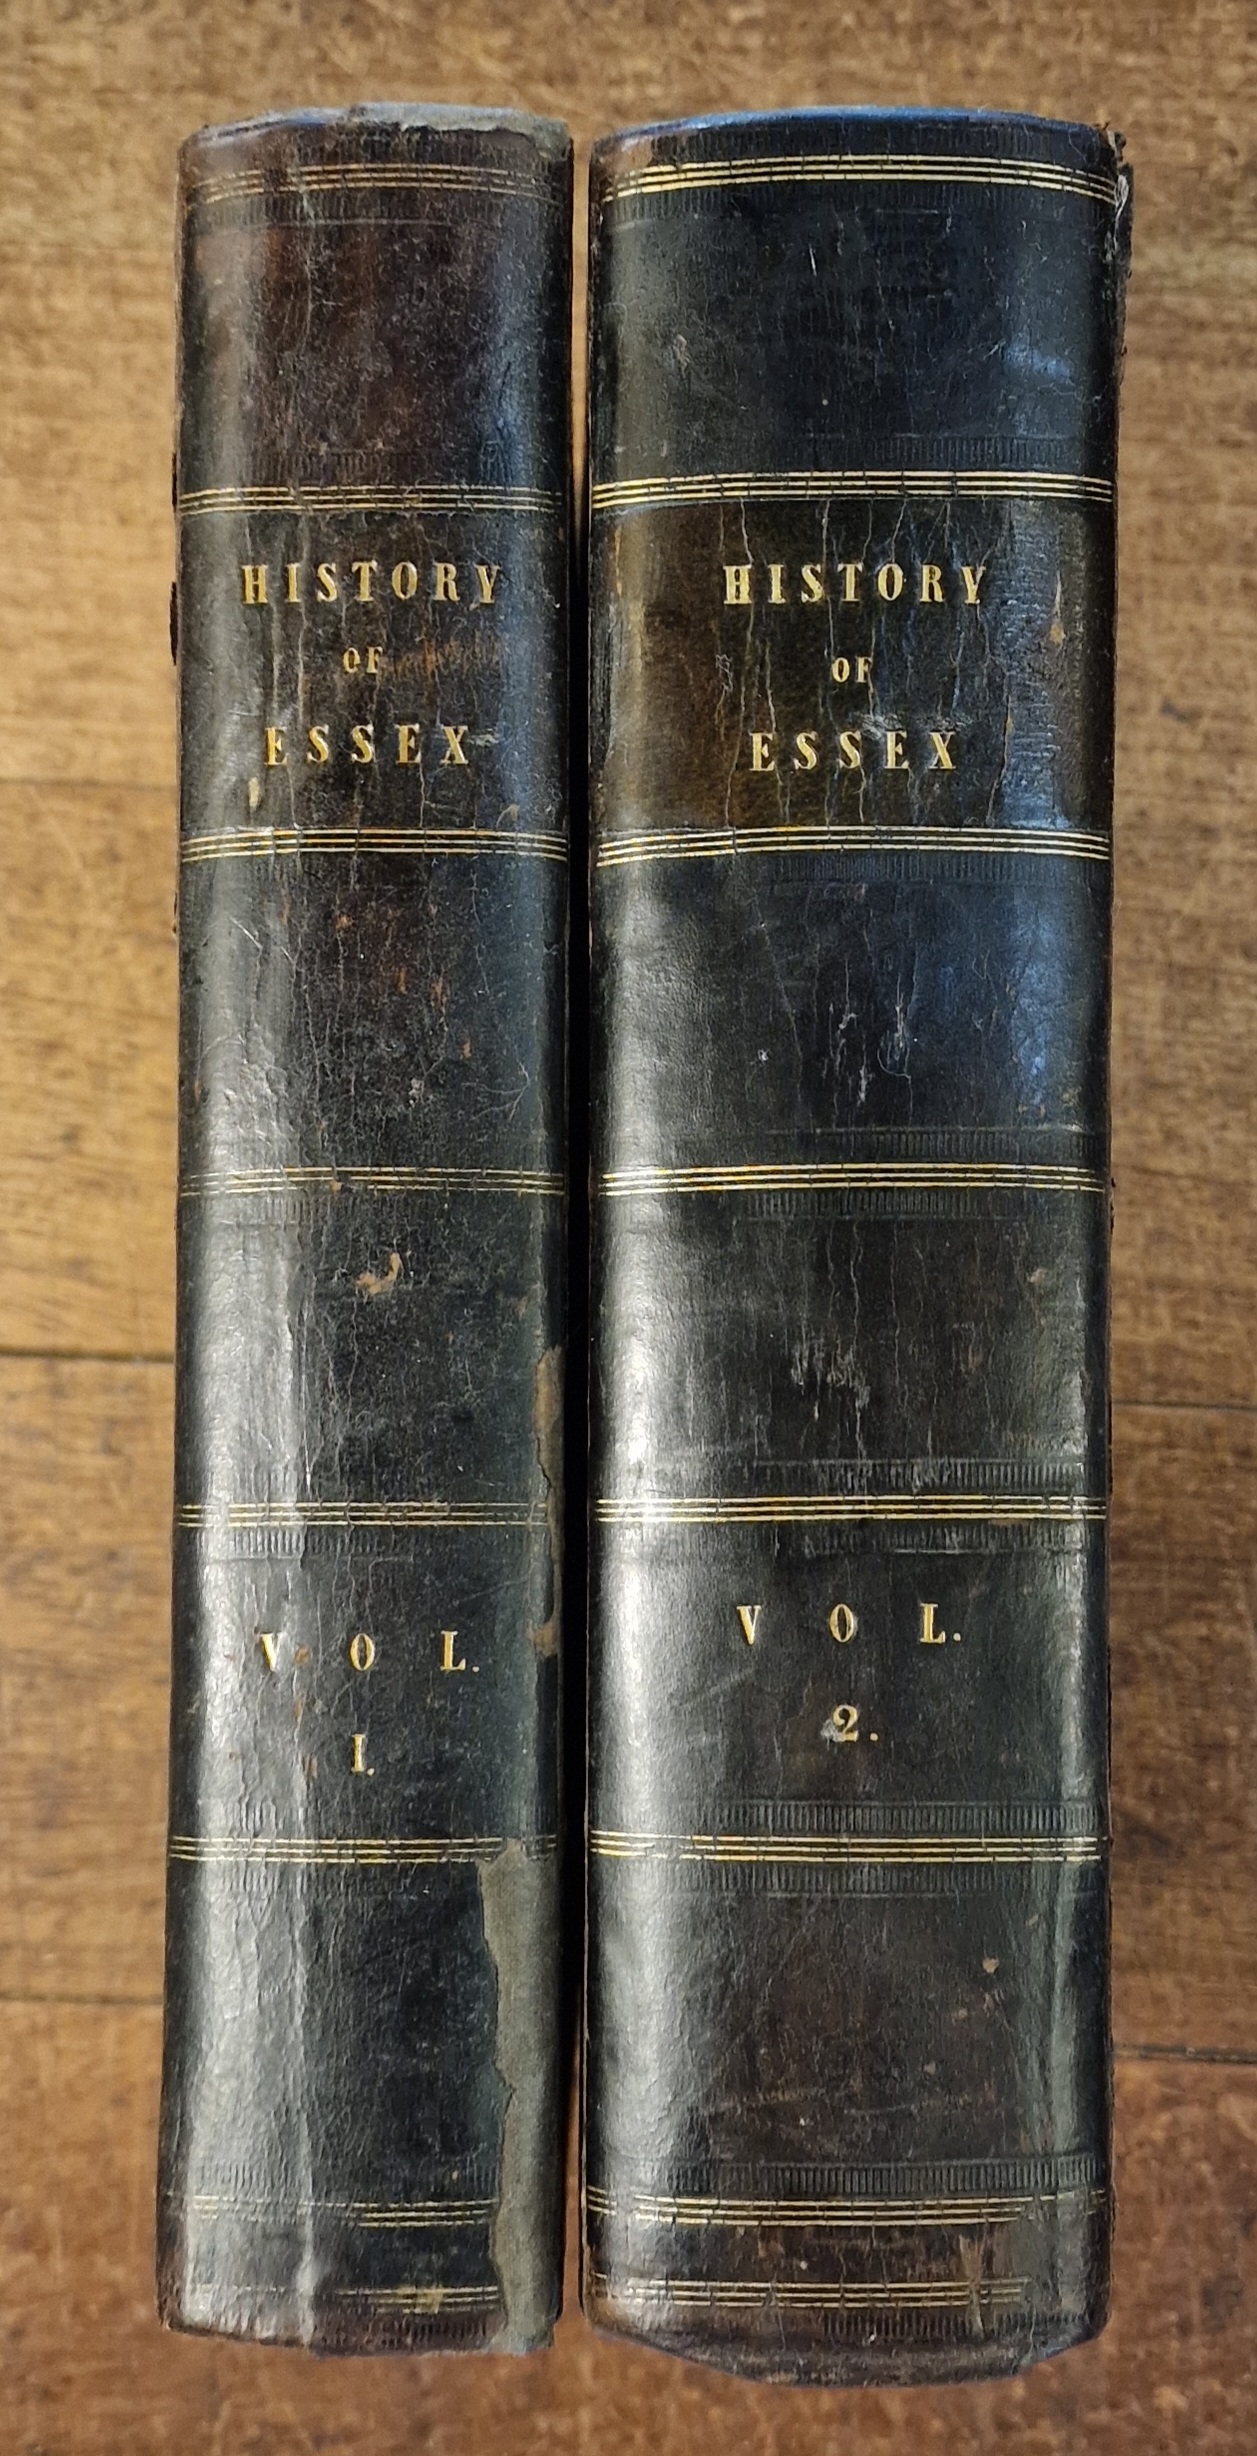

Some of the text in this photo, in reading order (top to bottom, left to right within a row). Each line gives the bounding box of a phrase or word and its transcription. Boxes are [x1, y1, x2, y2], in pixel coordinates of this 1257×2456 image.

[241, 560, 501, 605] HISTORY
[722, 562, 987, 606] HISTORY
[342, 646, 383, 675] OF
[831, 656, 873, 684] OF
[264, 723, 469, 766] ESSEX
[749, 730, 957, 772] ESSEX
[831, 1704, 879, 1743] 2.
